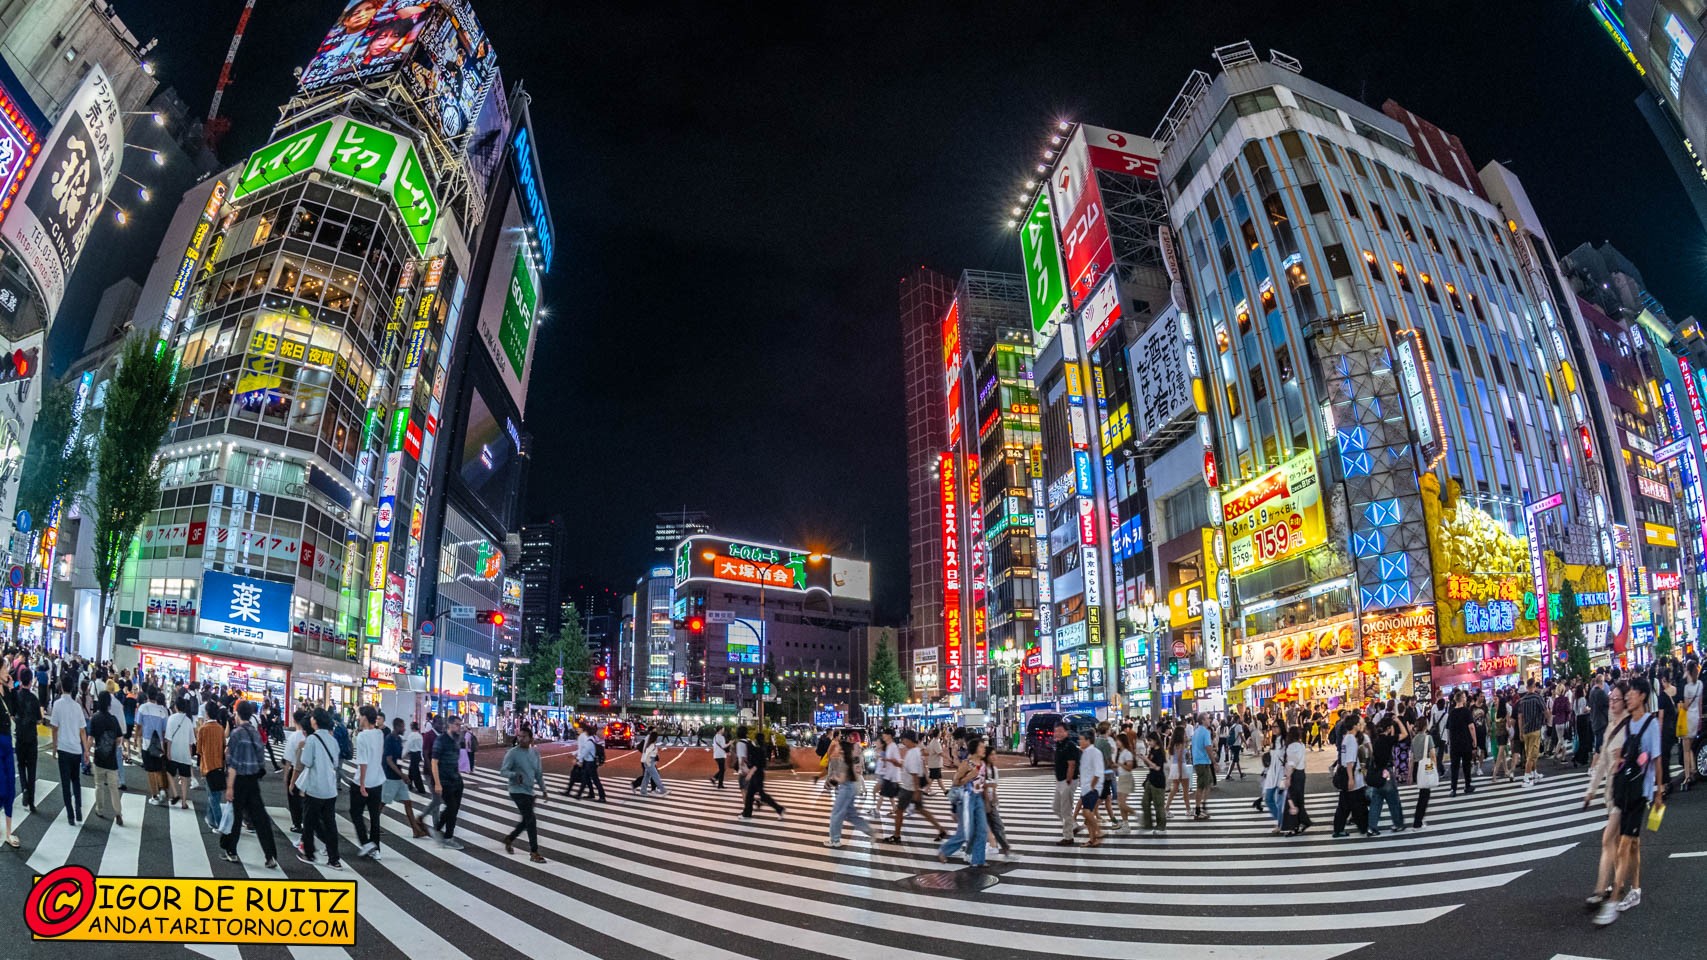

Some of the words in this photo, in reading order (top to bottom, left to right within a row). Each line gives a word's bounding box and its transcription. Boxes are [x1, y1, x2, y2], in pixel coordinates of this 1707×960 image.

[329, 63, 395, 85] CHOCOLATE
[246, 132, 318, 183] レイク
[400, 157, 432, 226] レイク
[1066, 202, 1100, 260] アコム
[512, 275, 531, 330] GOLF5
[280, 340, 305, 360] 祝日
[308, 347, 335, 367] 夜間
[1681, 361, 1698, 409] カラオケ
[1103, 412, 1131, 445] プロミス
[943, 458, 955, 502] パチンコ
[378, 509, 391, 523] 薬
[158, 526, 188, 541] アイフル
[191, 527, 203, 541] 3F
[240, 531, 297, 554] アイフル
[1254, 523, 1290, 560] 159
[302, 548, 312, 562] 3F
[728, 542, 780, 565] たのめーる
[720, 562, 789, 584] 大塚商会
[228, 582, 263, 623] 薬
[1608, 573, 1618, 611] トラノコ
[948, 609, 960, 647] パチンコ
[1361, 615, 1435, 635] OKONOMIYAKI
[1464, 600, 1514, 634] 飲み放題
[1368, 628, 1431, 648] お好み焼き
